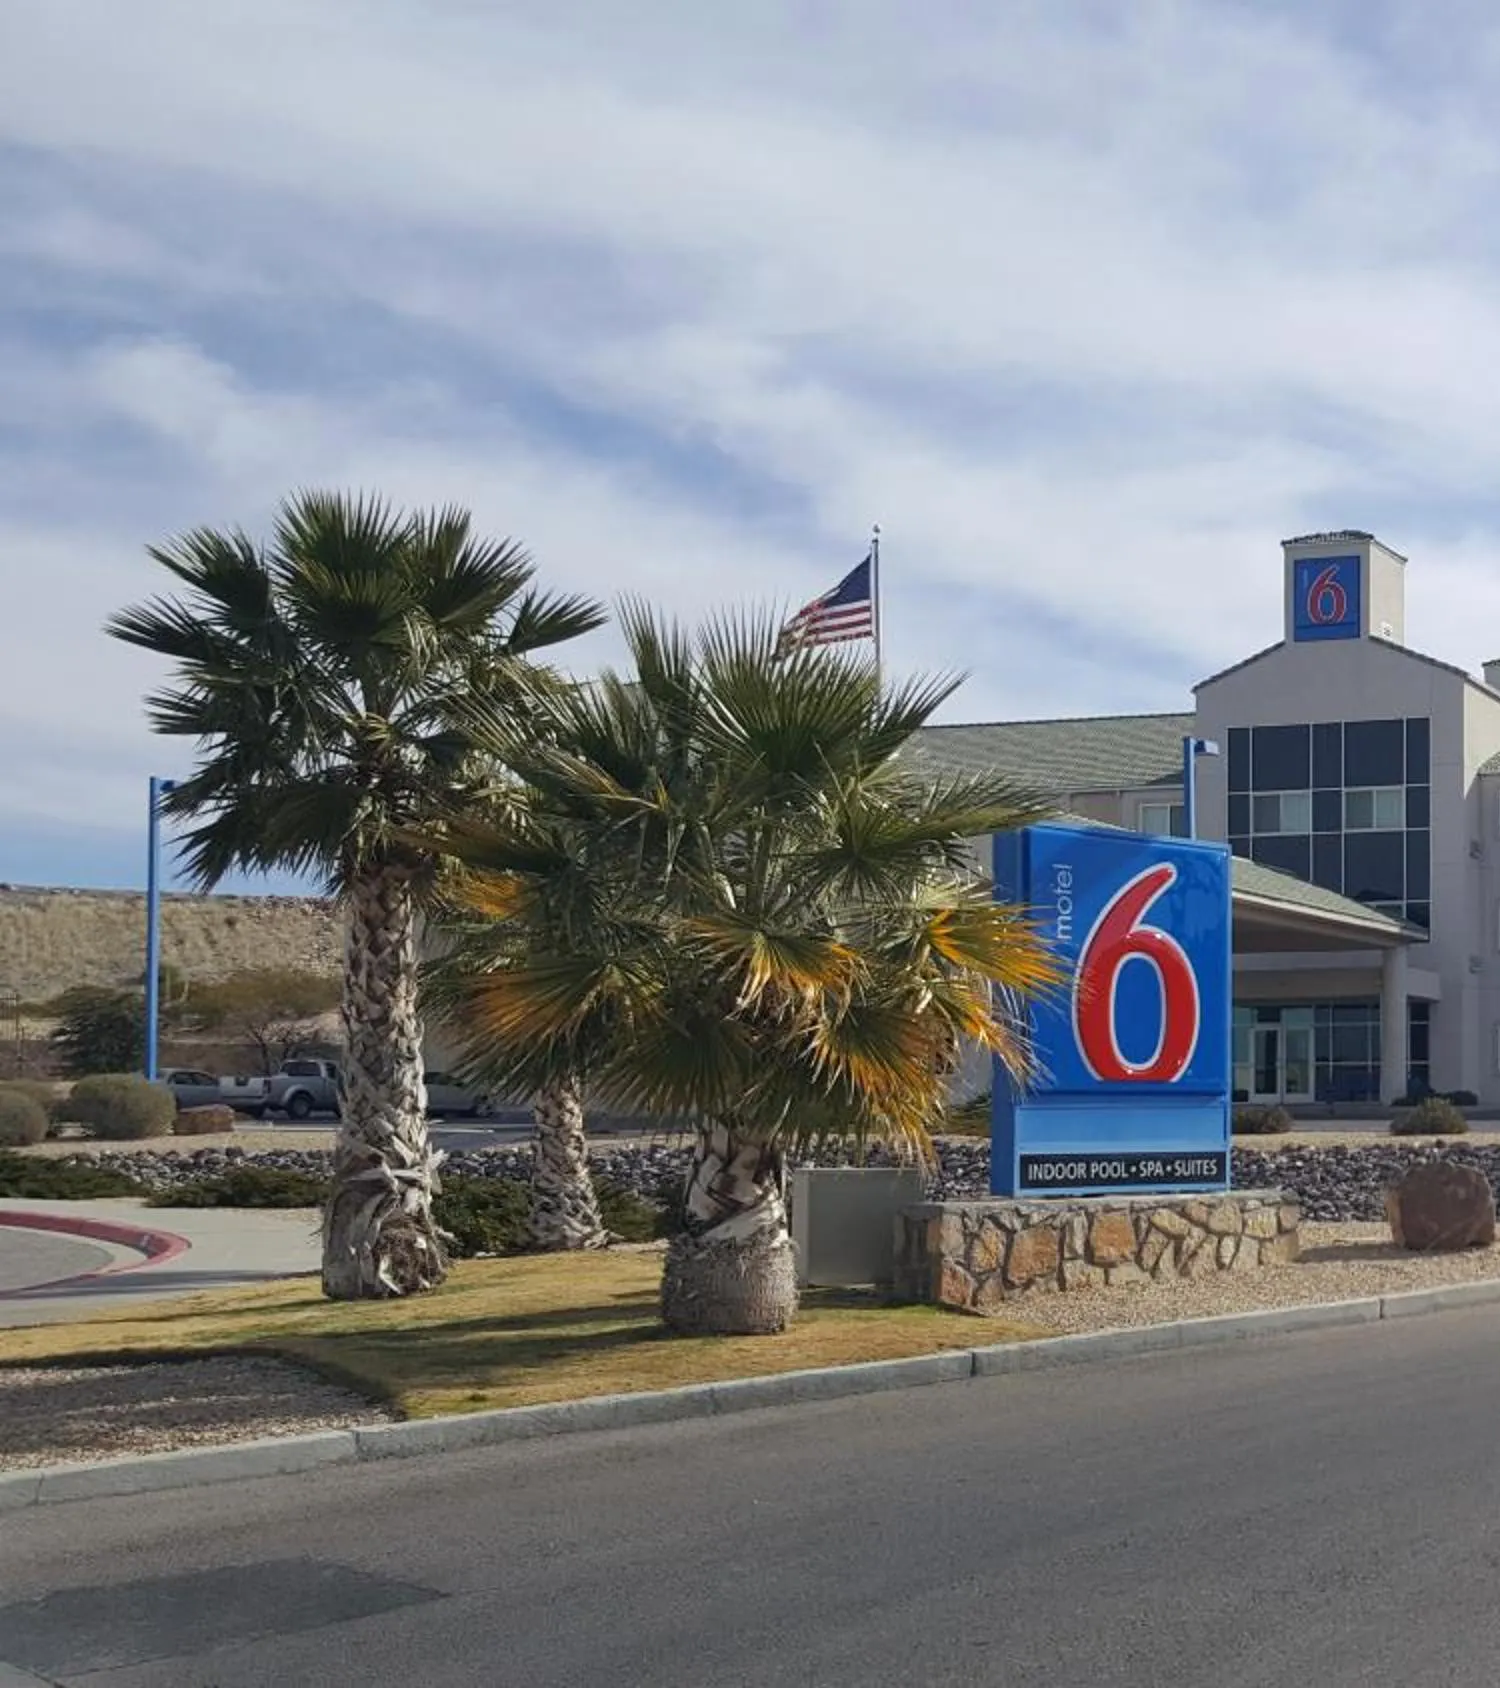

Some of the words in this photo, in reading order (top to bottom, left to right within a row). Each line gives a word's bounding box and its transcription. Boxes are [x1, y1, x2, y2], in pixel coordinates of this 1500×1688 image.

[1307, 563, 1347, 625] 6
[1052, 863, 1073, 939] motel
[1071, 861, 1200, 1083] 6
[1027, 1163, 1087, 1181] INDOOR
[1091, 1161, 1129, 1180] POOL
[1139, 1160, 1164, 1178] SPA
[1173, 1159, 1218, 1177] SUITES
